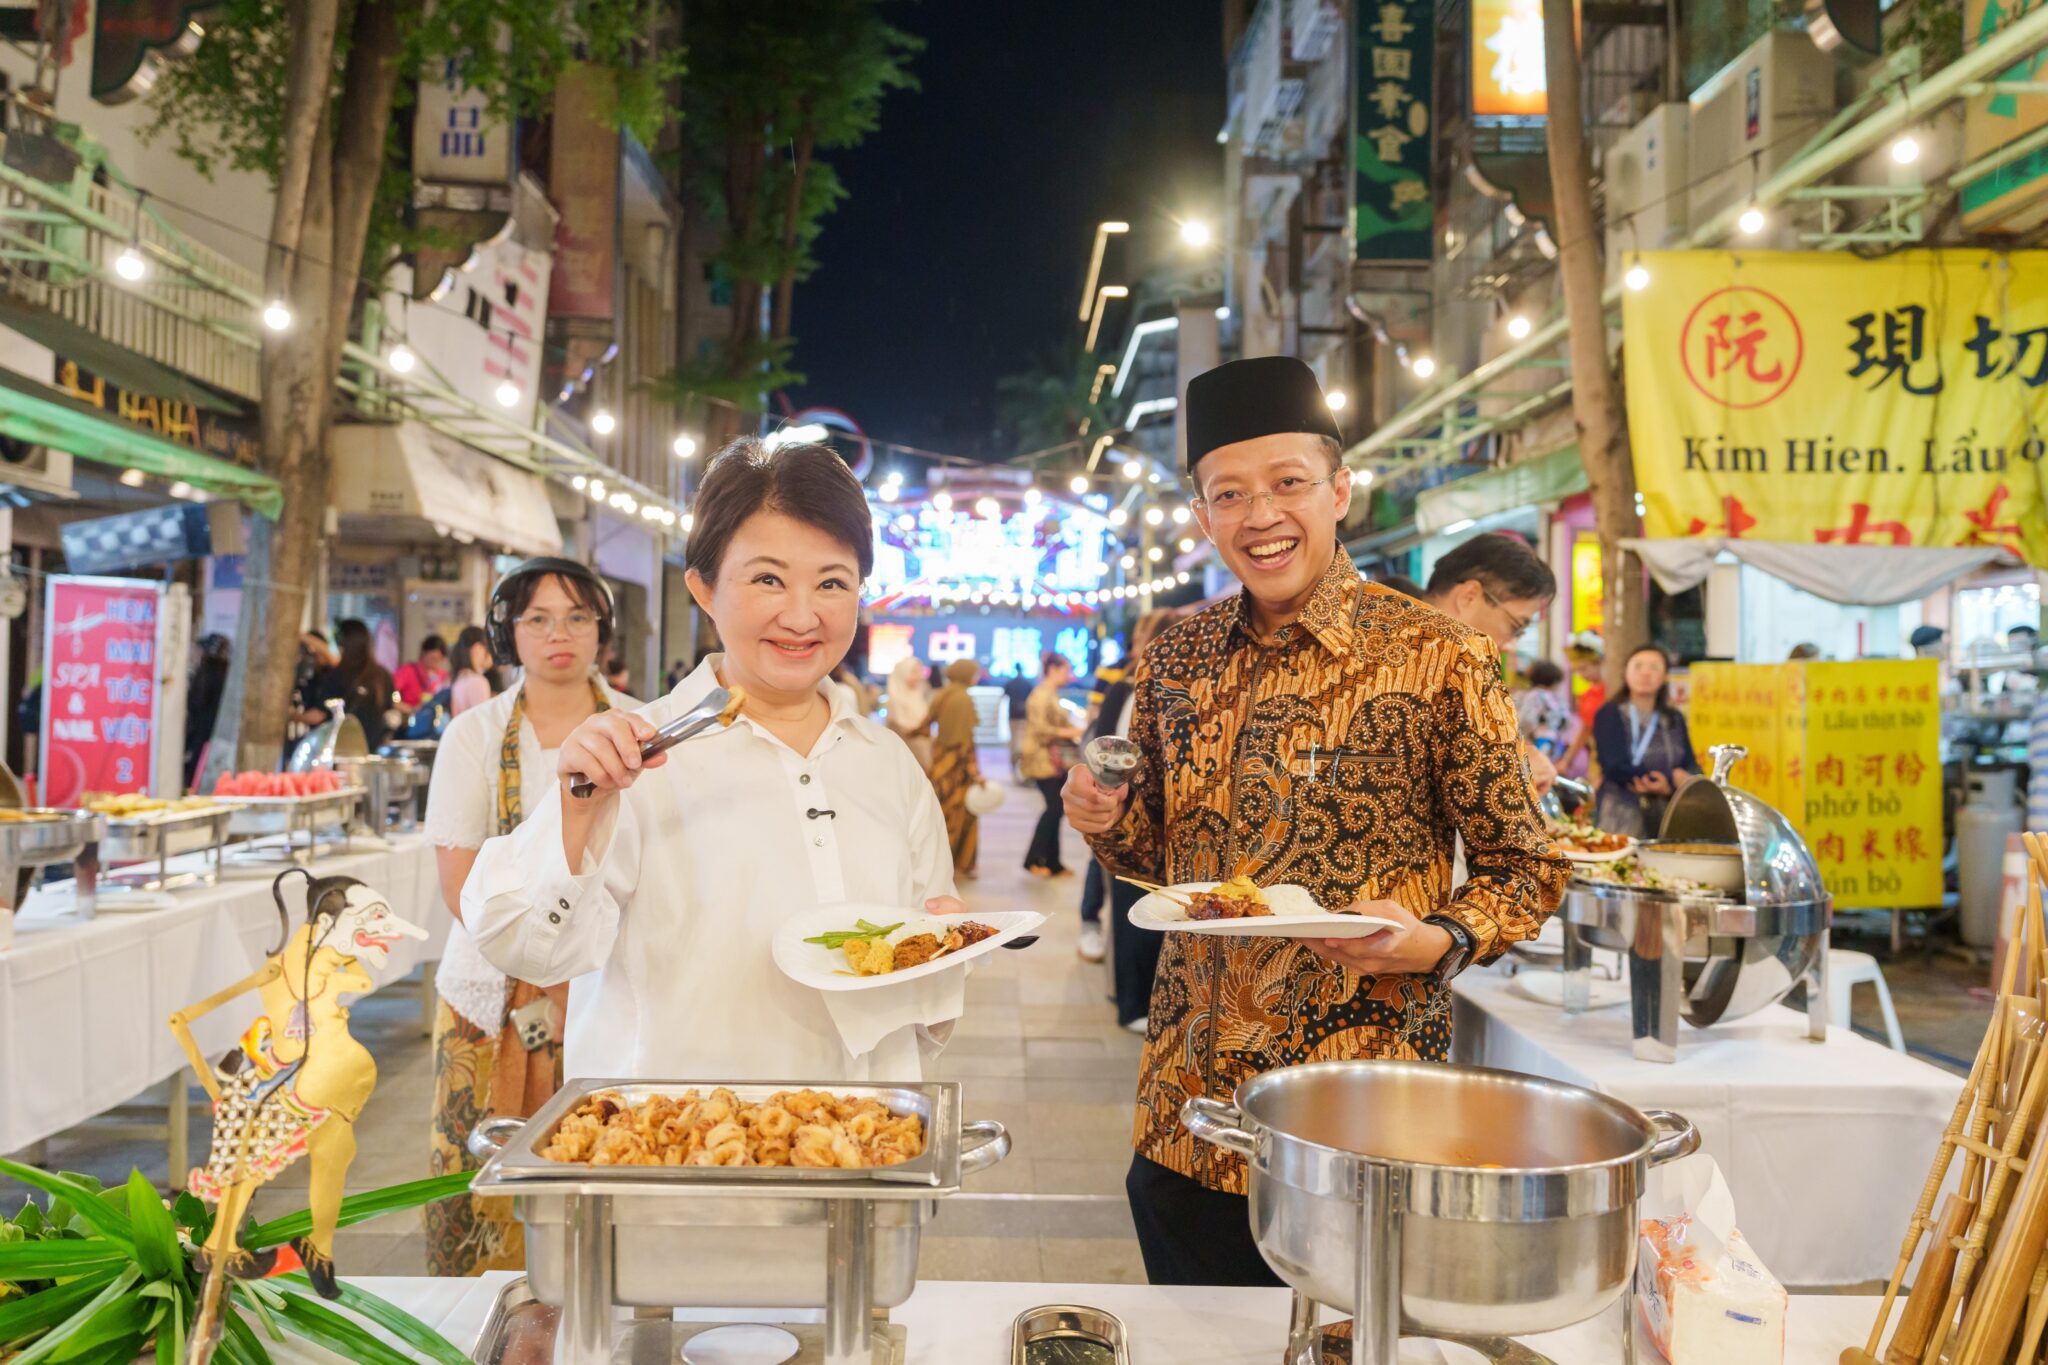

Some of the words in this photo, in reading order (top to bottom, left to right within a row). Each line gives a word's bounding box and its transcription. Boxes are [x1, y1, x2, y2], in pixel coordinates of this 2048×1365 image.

[1704, 311, 1784, 384] 阮
[1683, 436, 1768, 472] Kim
[1786, 436, 1906, 473] Hien.
[1921, 427, 2008, 473] Lẩu
[105, 600, 154, 623] HOA
[105, 638, 153, 664] MAI
[52, 662, 101, 689] SPA
[104, 673, 150, 705] TÓC
[67, 692, 86, 715] &
[53, 718, 98, 742] NAIL
[115, 757, 134, 784] 2
[1804, 789, 1860, 825] phở
[1867, 788, 1903, 816] bò
[1824, 868, 1859, 896] ún
[1867, 866, 1903, 896] bò
